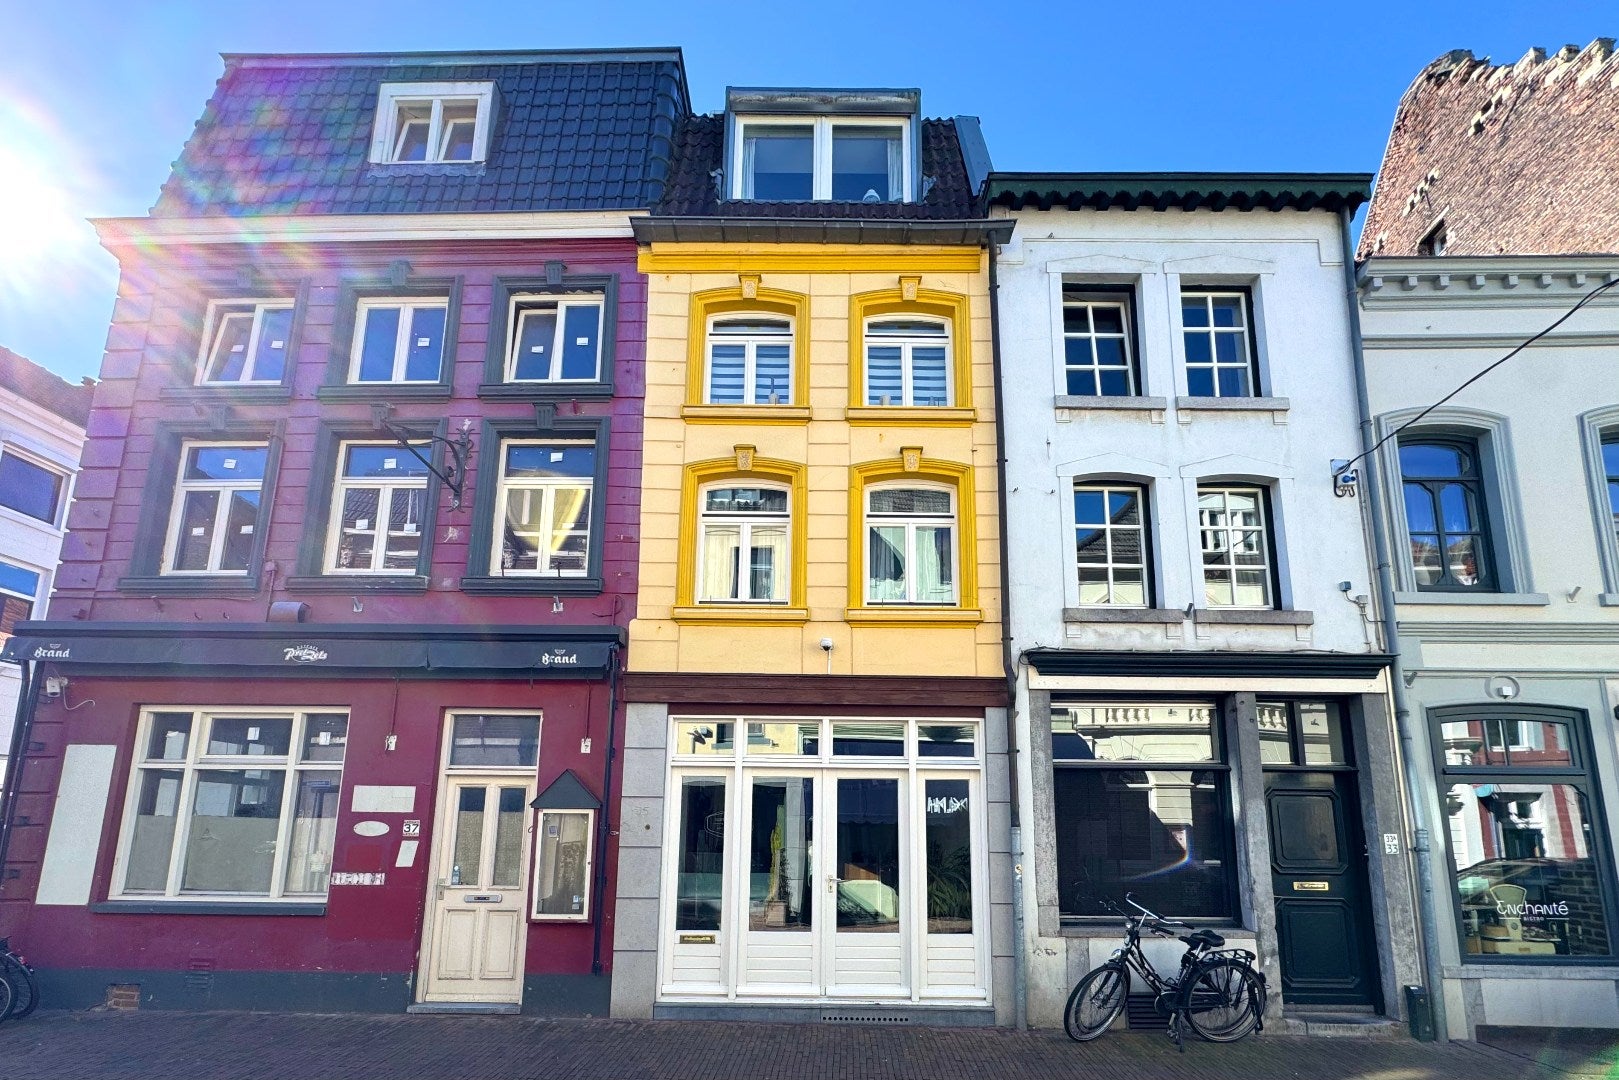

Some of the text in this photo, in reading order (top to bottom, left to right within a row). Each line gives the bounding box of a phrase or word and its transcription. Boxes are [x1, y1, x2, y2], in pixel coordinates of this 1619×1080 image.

[33, 646, 70, 658] Brand
[541, 652, 577, 665] Brand
[403, 823, 419, 833] 37
[1387, 844, 1399, 854] 33
